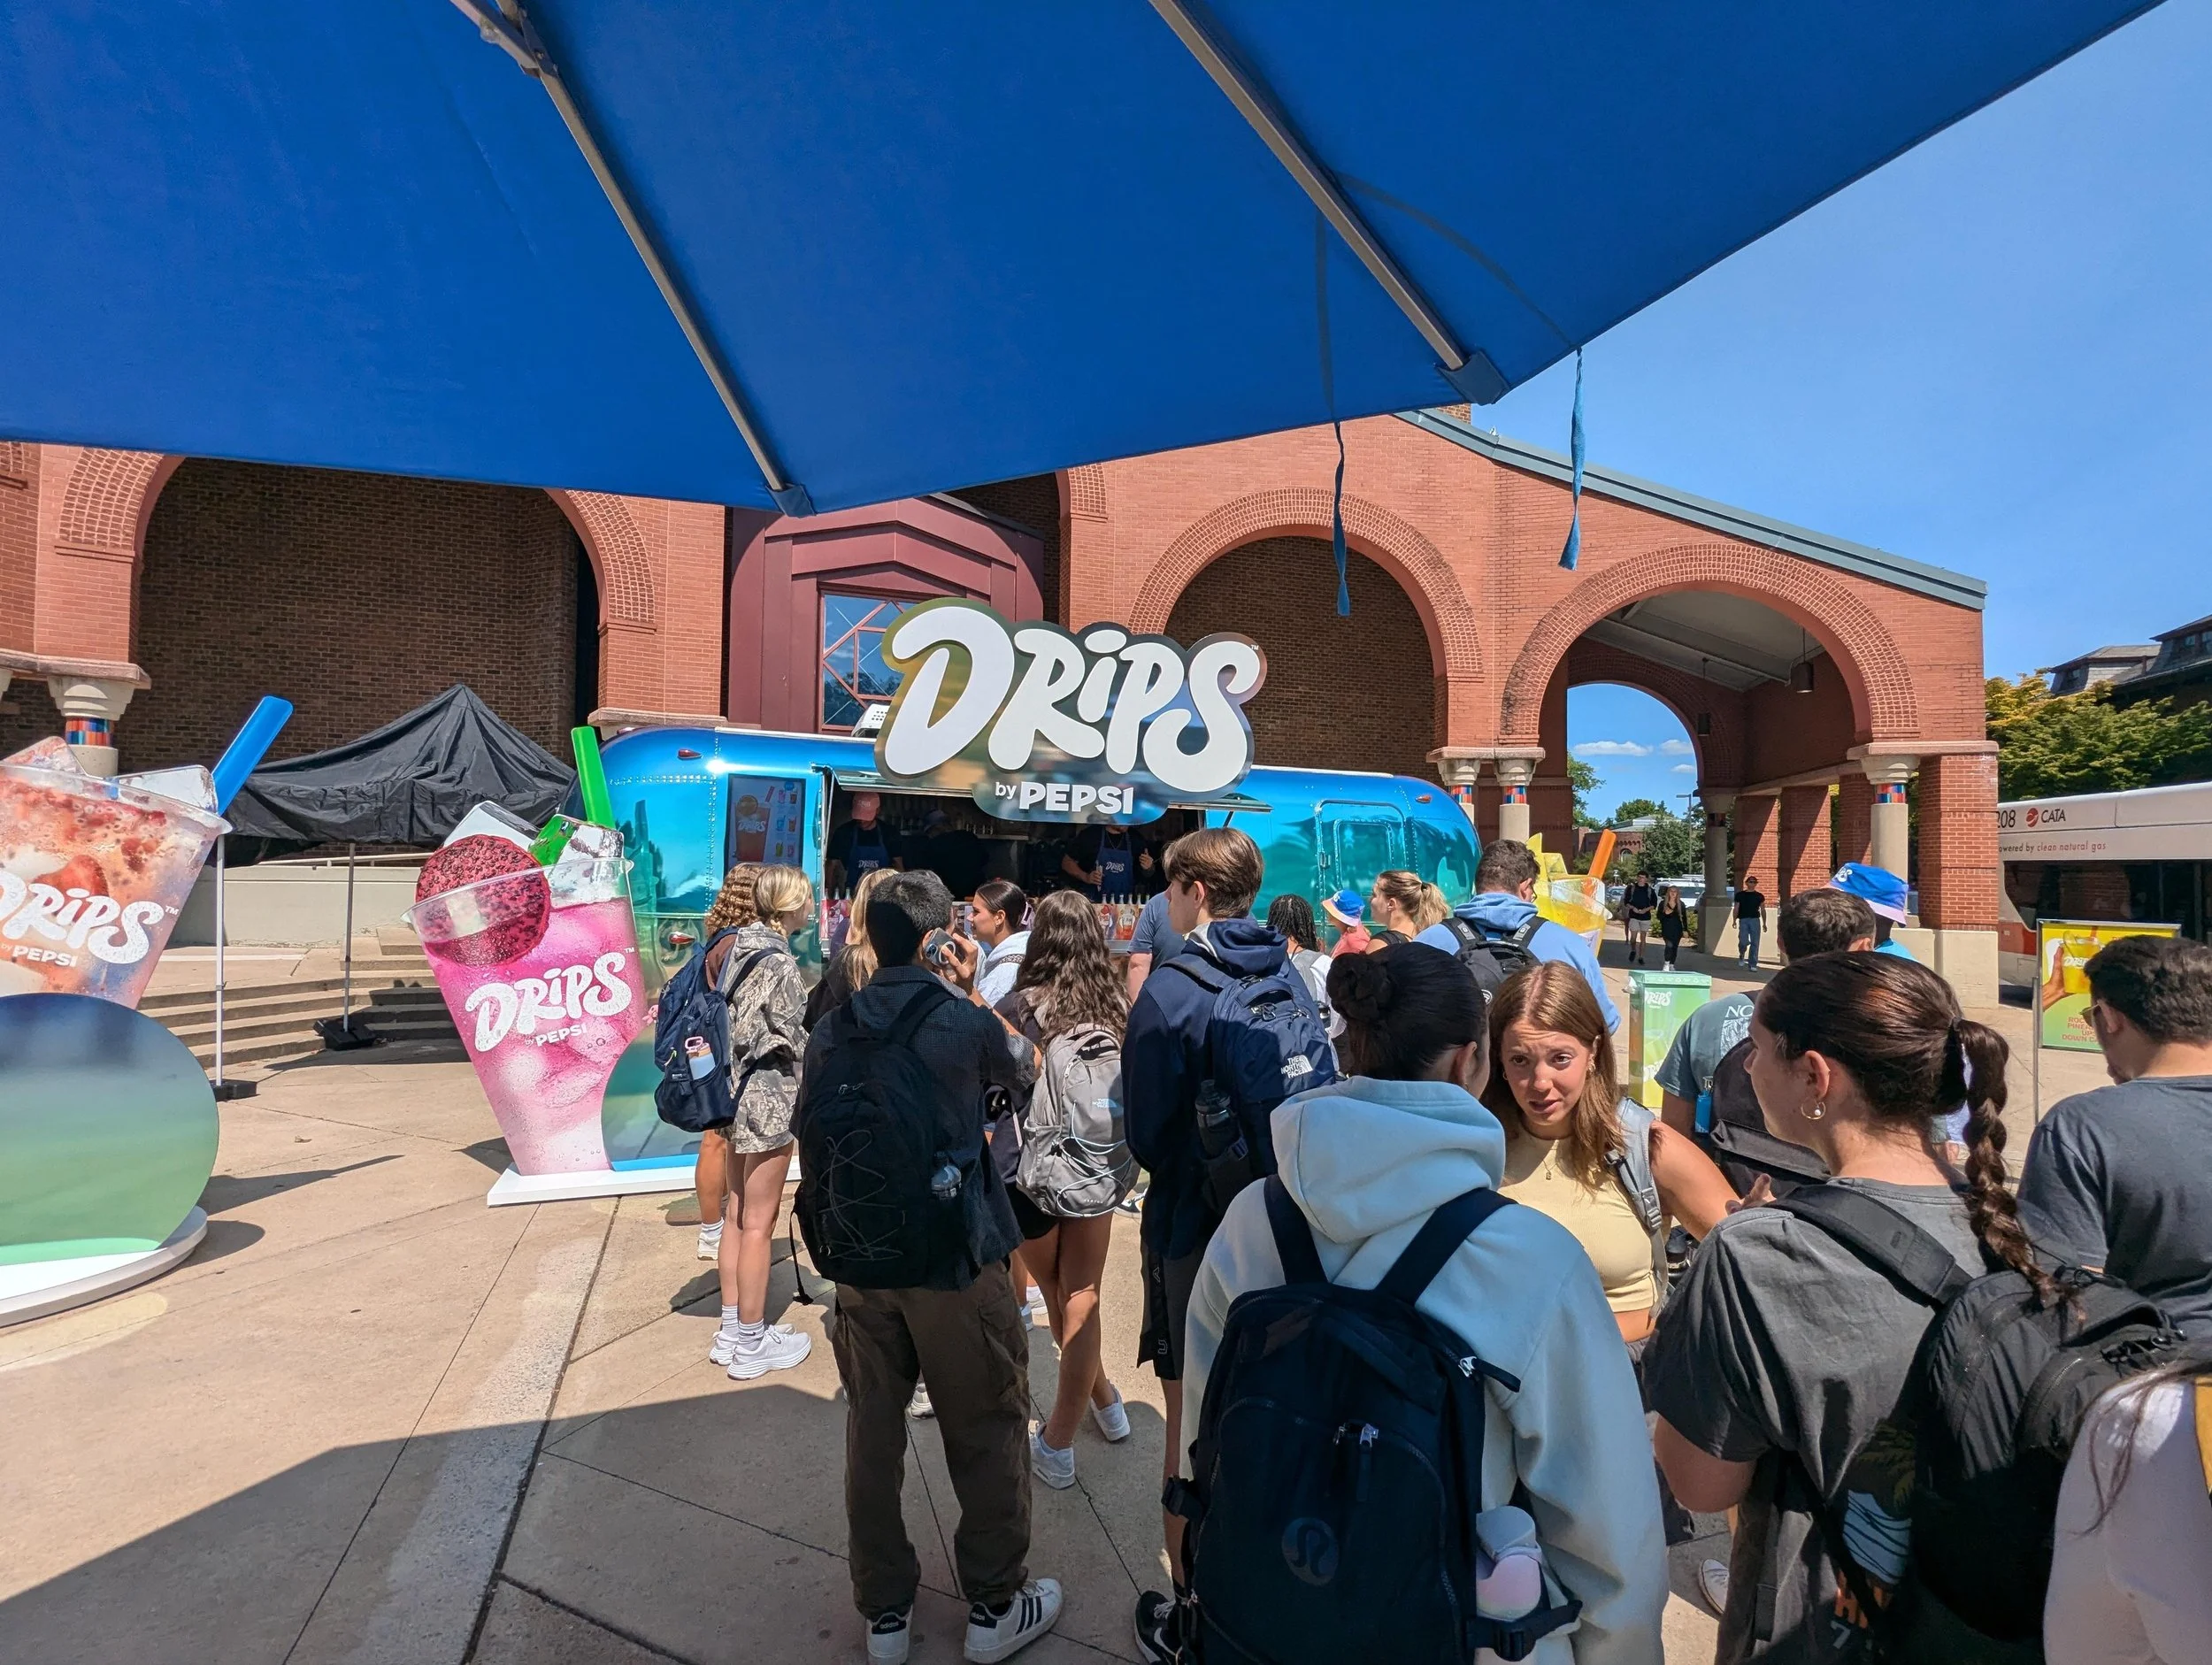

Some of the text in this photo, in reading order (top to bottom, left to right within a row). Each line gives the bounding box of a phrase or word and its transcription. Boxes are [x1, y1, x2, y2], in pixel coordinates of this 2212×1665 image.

[995, 781, 1134, 815] by PEPSI
[2041, 809, 2066, 823] CATA
[2026, 841, 2034, 853] by
[2037, 841, 2056, 852] clean
[2060, 840, 2088, 851] natural
[2092, 842, 2106, 853] gas
[12, 945, 78, 968] PEPSI
[535, 1023, 588, 1047] PEPSI
[1280, 1063, 1302, 1074] NORTH
[1287, 1070, 1304, 1078] FACE
